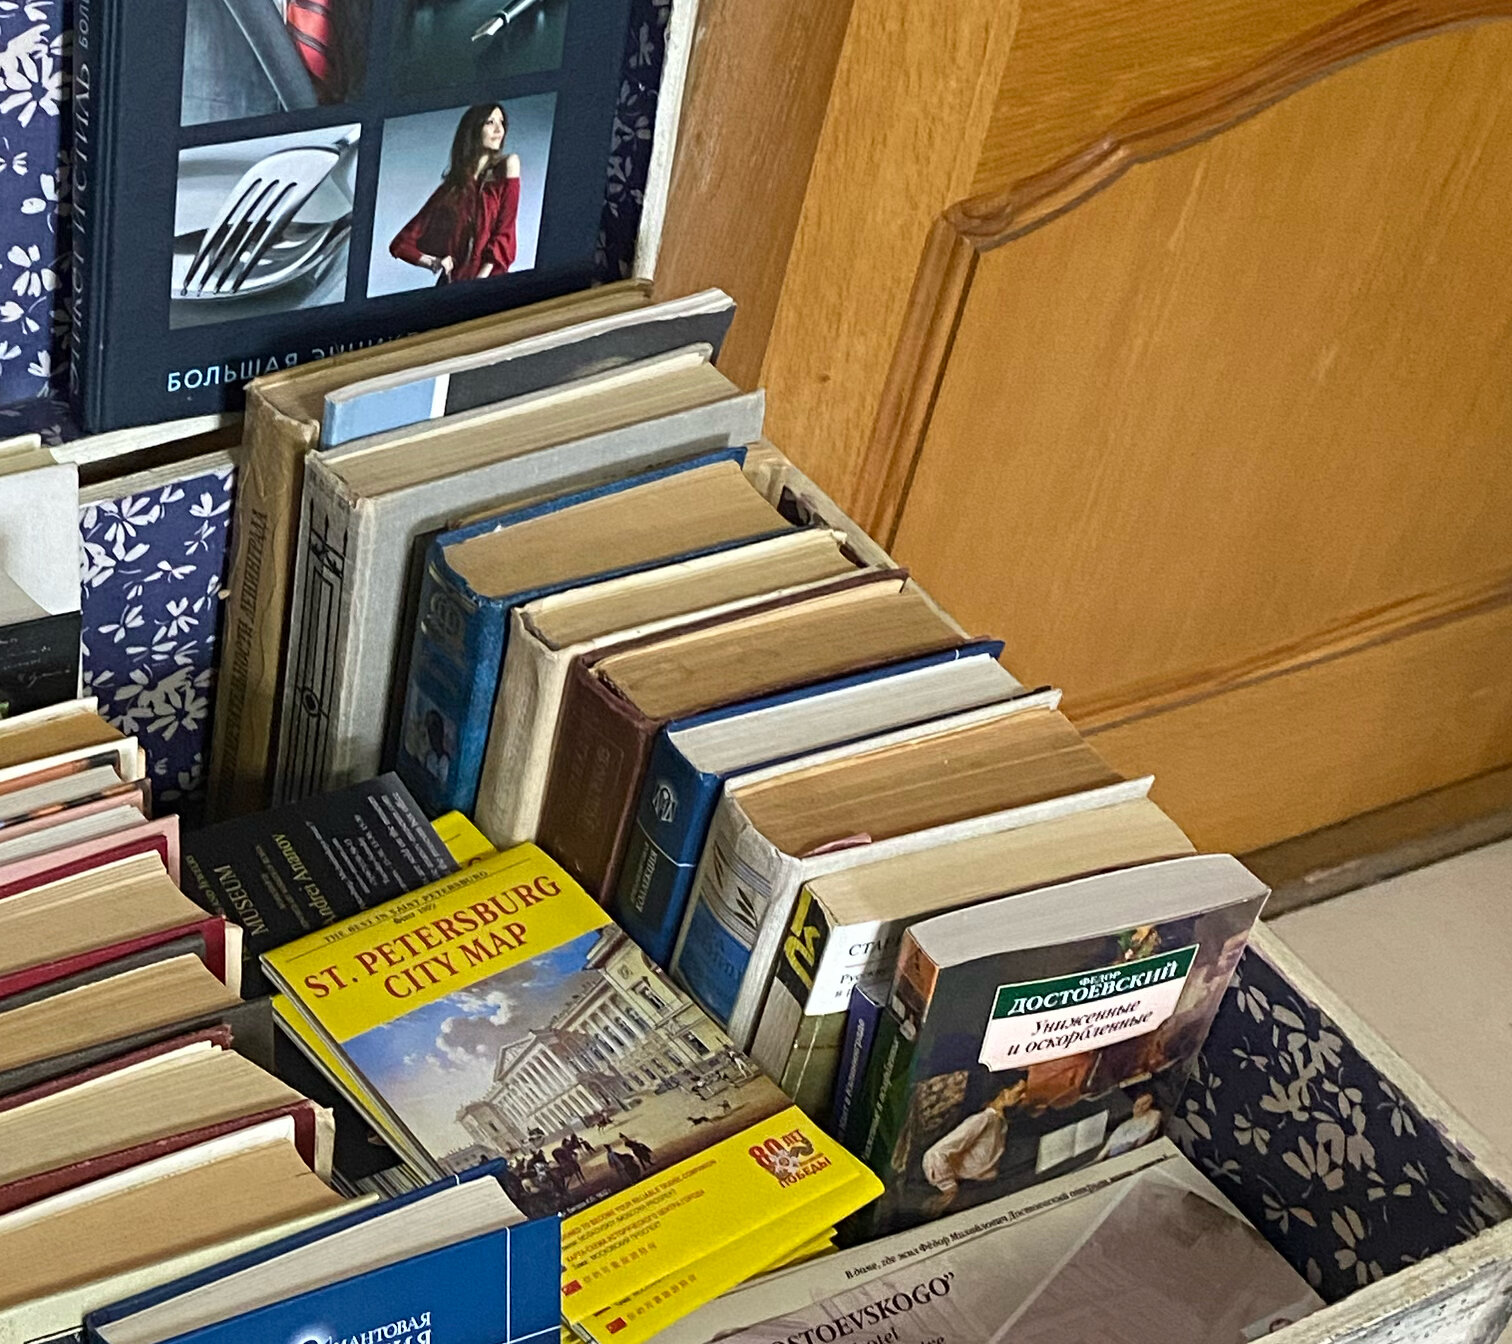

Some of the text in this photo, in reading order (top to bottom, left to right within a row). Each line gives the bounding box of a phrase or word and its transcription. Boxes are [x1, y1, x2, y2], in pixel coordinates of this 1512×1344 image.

[167, 352, 298, 392] БОЛЬШАЯ
[237, 508, 269, 622] ЛЕНИНГРАДА
[389, 788, 410, 814] office
[270, 826, 313, 887] Ananov
[399, 845, 416, 866] sold
[213, 858, 270, 940] MUSEUM
[296, 877, 339, 931] Andrei
[323, 928, 345, 945] THE
[343, 914, 375, 937] BEST
[373, 909, 389, 923] IN
[387, 894, 422, 920] SAINT
[421, 864, 489, 907] PETERSBURG
[301, 955, 360, 1005] ST.
[352, 858, 563, 990] PETERSBURG
[380, 913, 533, 1006] CITY MAP
[1004, 958, 1181, 1020] ДОСТОЕВСКИЙ
[1004, 1008, 1156, 1058] и оскорбленные
[1027, 995, 1143, 1038] Униженные
[746, 1126, 807, 1175] 80 ЛЕТ
[778, 1155, 832, 1189] ПОБЕДЫ
